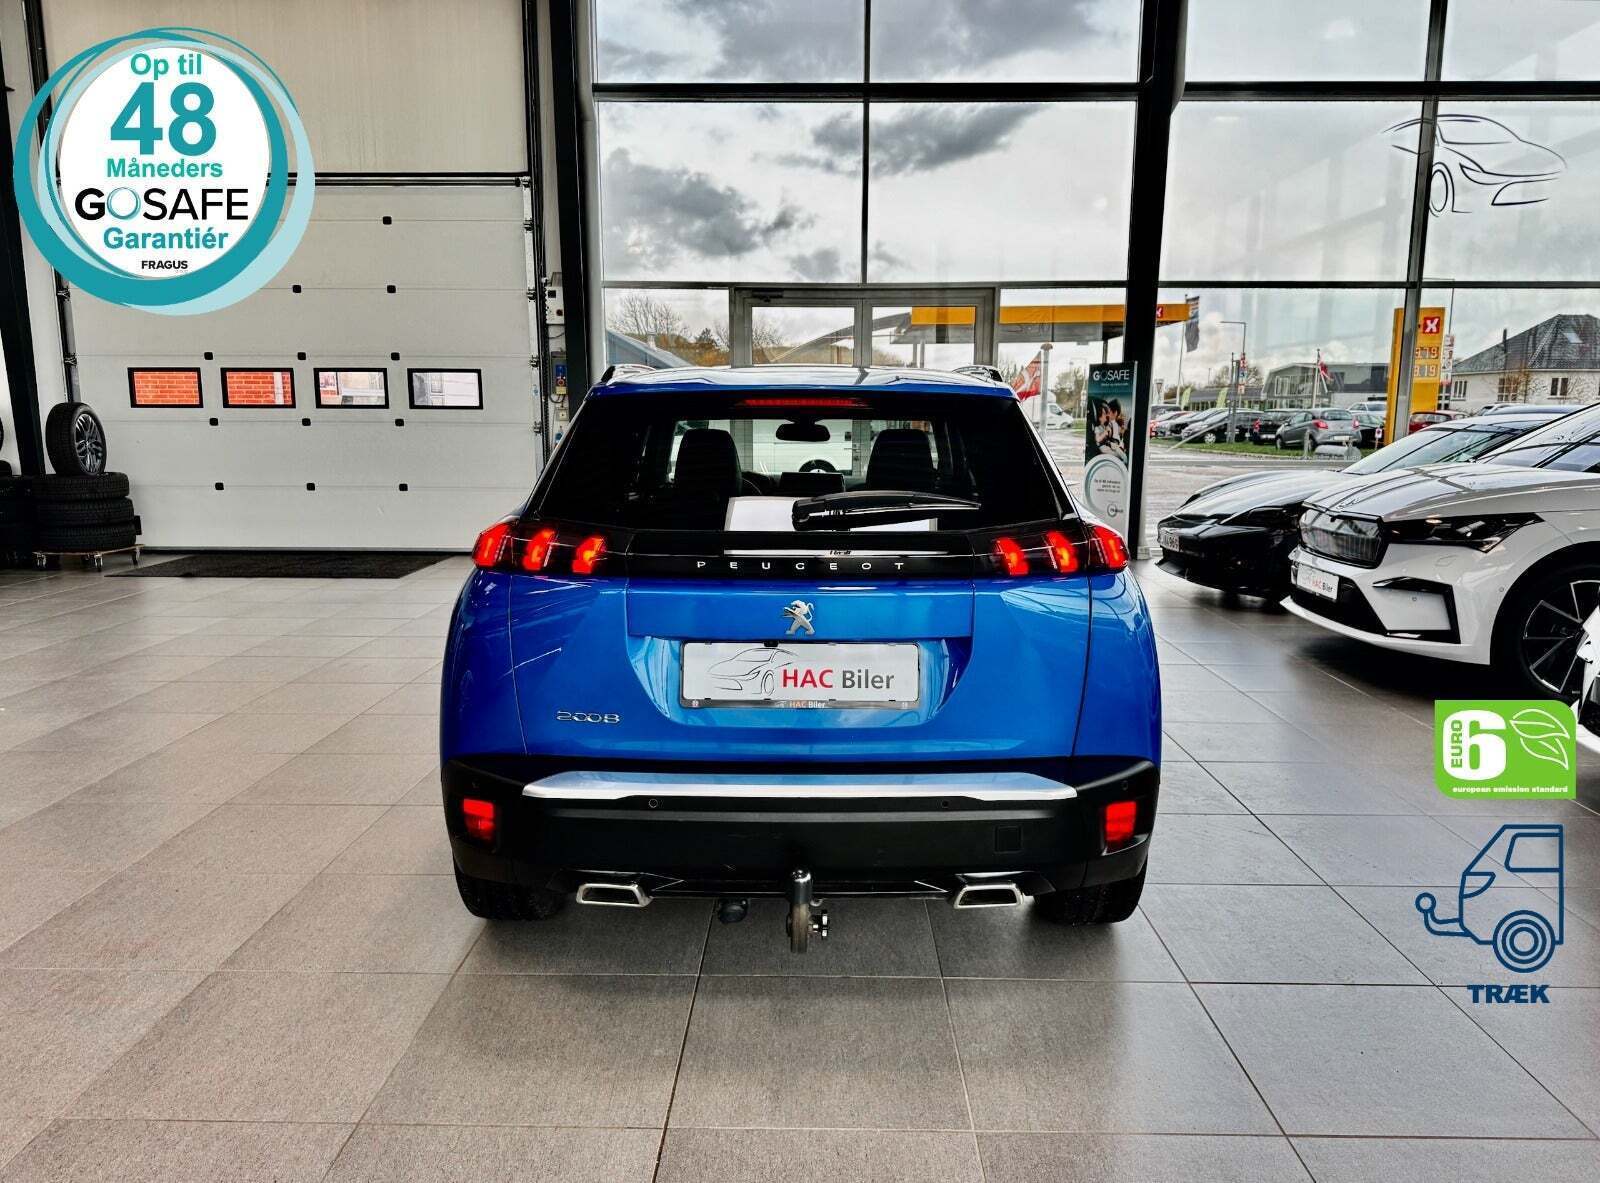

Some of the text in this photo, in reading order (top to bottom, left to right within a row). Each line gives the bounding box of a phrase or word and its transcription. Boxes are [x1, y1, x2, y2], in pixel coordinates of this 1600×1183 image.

[1093, 369, 1130, 381] GOSAFE
[697, 561, 904, 571] PEUGEOT
[782, 668, 895, 689] HAC Biler
[808, 700, 826, 709] Biler
[556, 710, 621, 724] 2008
